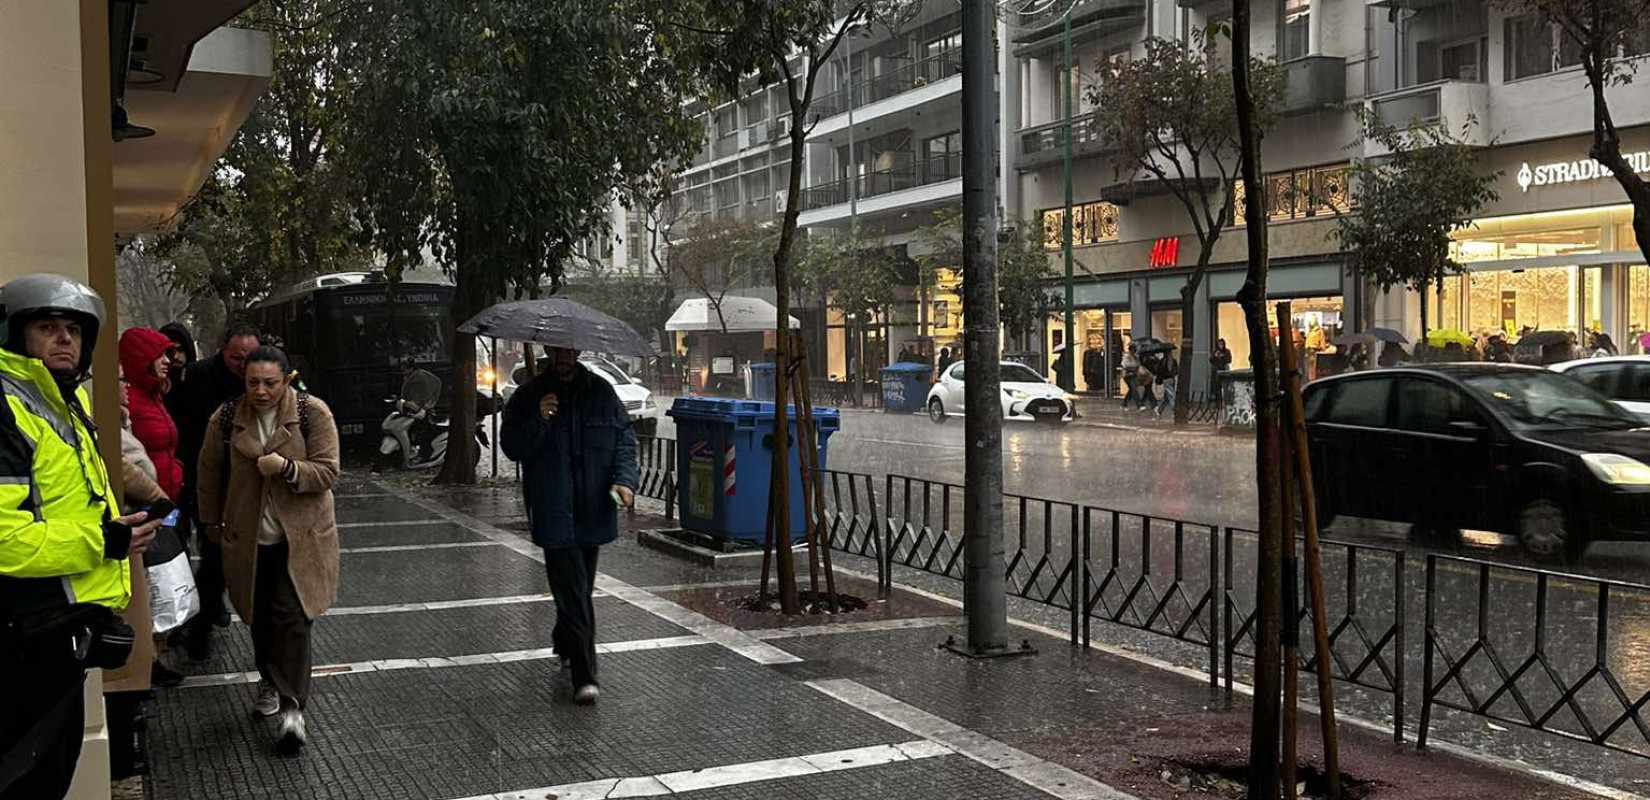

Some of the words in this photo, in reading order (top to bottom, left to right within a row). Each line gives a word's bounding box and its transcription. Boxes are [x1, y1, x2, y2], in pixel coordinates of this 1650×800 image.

[1534, 151, 1650, 185] STRADIVIU
[1149, 236, 1178, 267] H&M
[393, 293, 439, 303] ΣΥΝΟΜΙΑ
